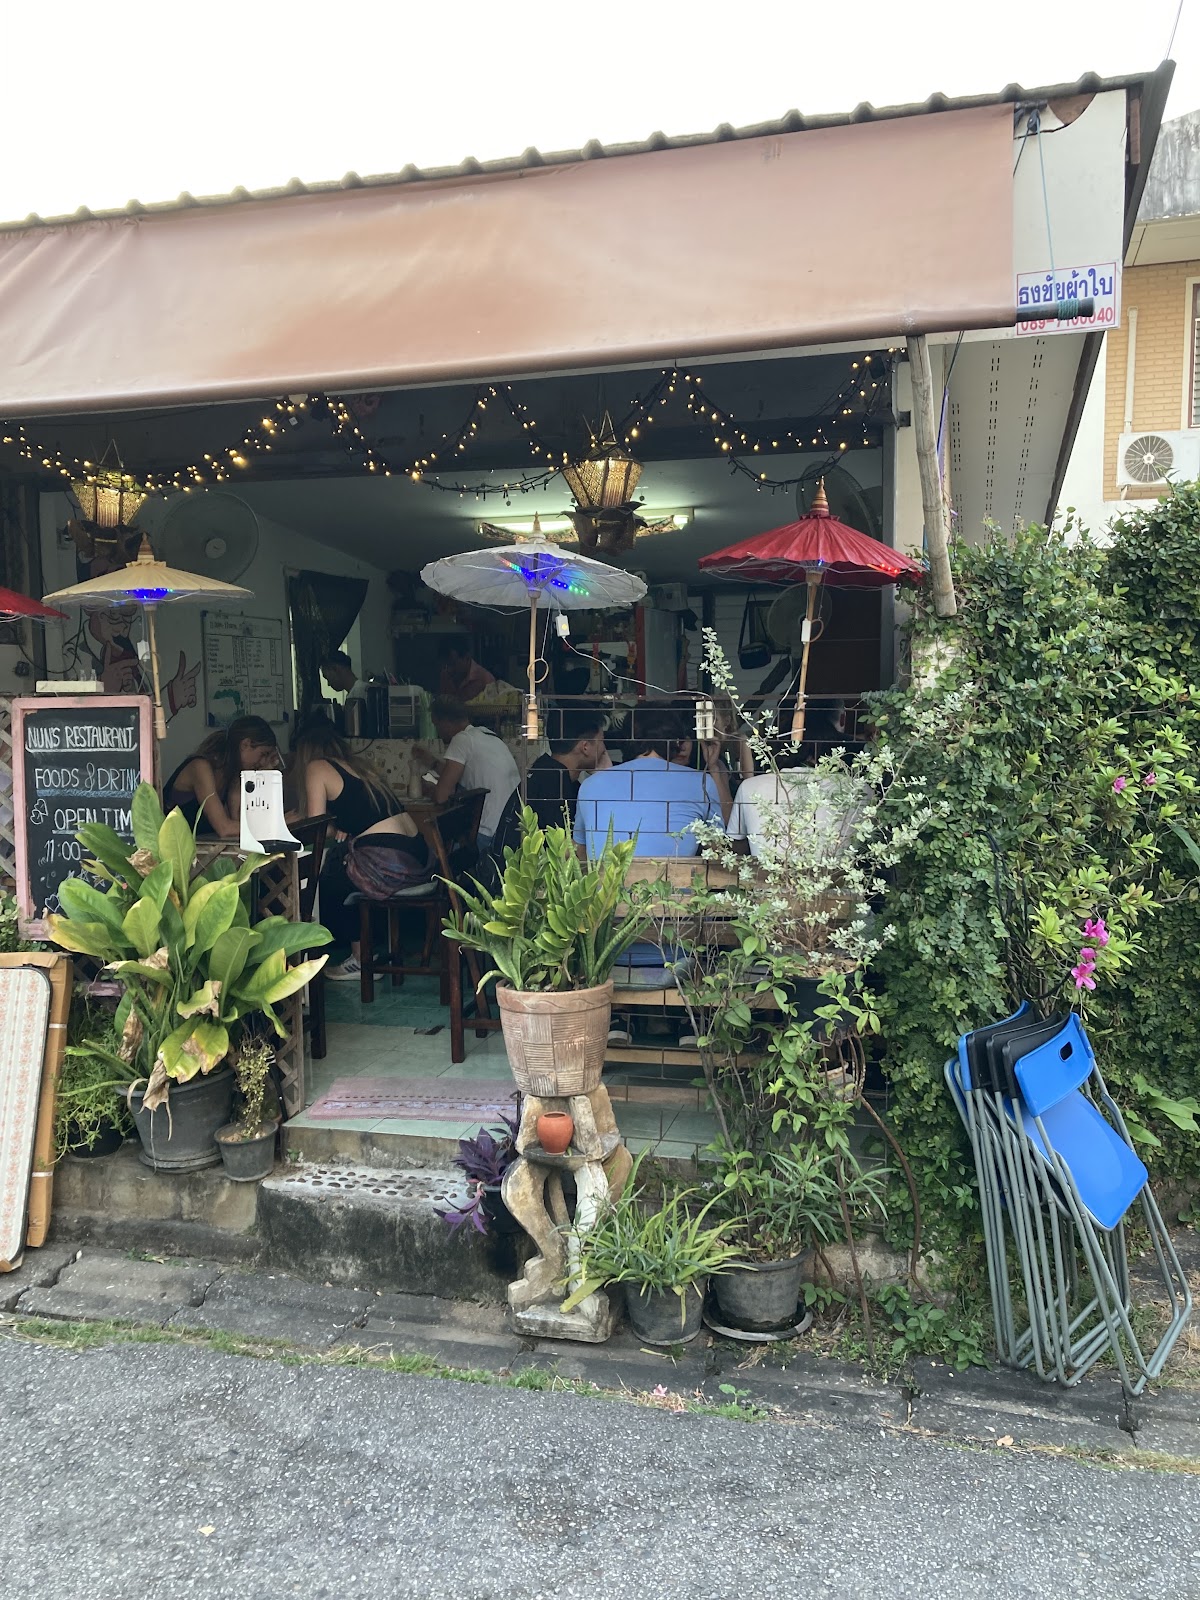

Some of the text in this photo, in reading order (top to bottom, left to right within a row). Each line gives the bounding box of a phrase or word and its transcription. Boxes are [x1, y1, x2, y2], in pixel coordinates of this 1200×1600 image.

[1018, 267, 1113, 305] ธงชัยผ้าใบ
[65, 726, 134, 748] RESTAURANT
[35, 768, 79, 789] FOODS
[54, 808, 133, 832] OPEN TIM
